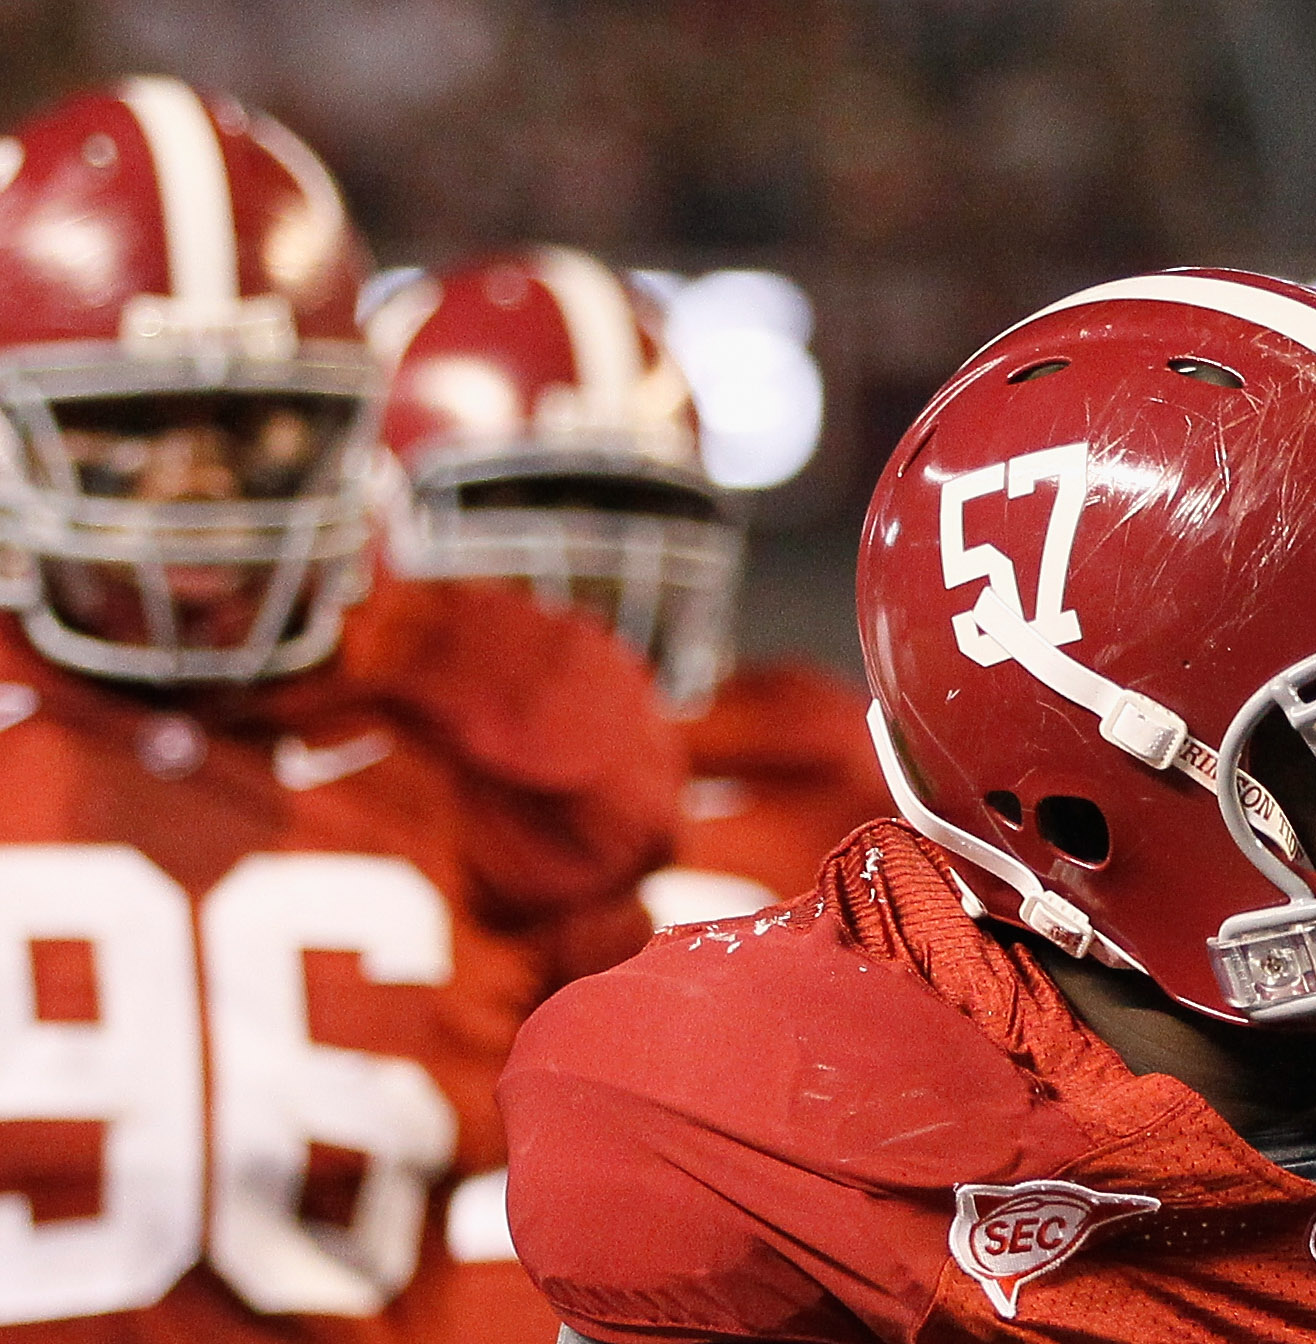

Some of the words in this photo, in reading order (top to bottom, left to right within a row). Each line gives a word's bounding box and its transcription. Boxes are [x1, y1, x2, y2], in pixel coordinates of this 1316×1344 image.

[940, 442, 1088, 667] 57
[1180, 738, 1276, 820] RISON
[1278, 811, 1304, 860] TID
[0, 843, 458, 1326] 96
[984, 1216, 1066, 1256] SEC
